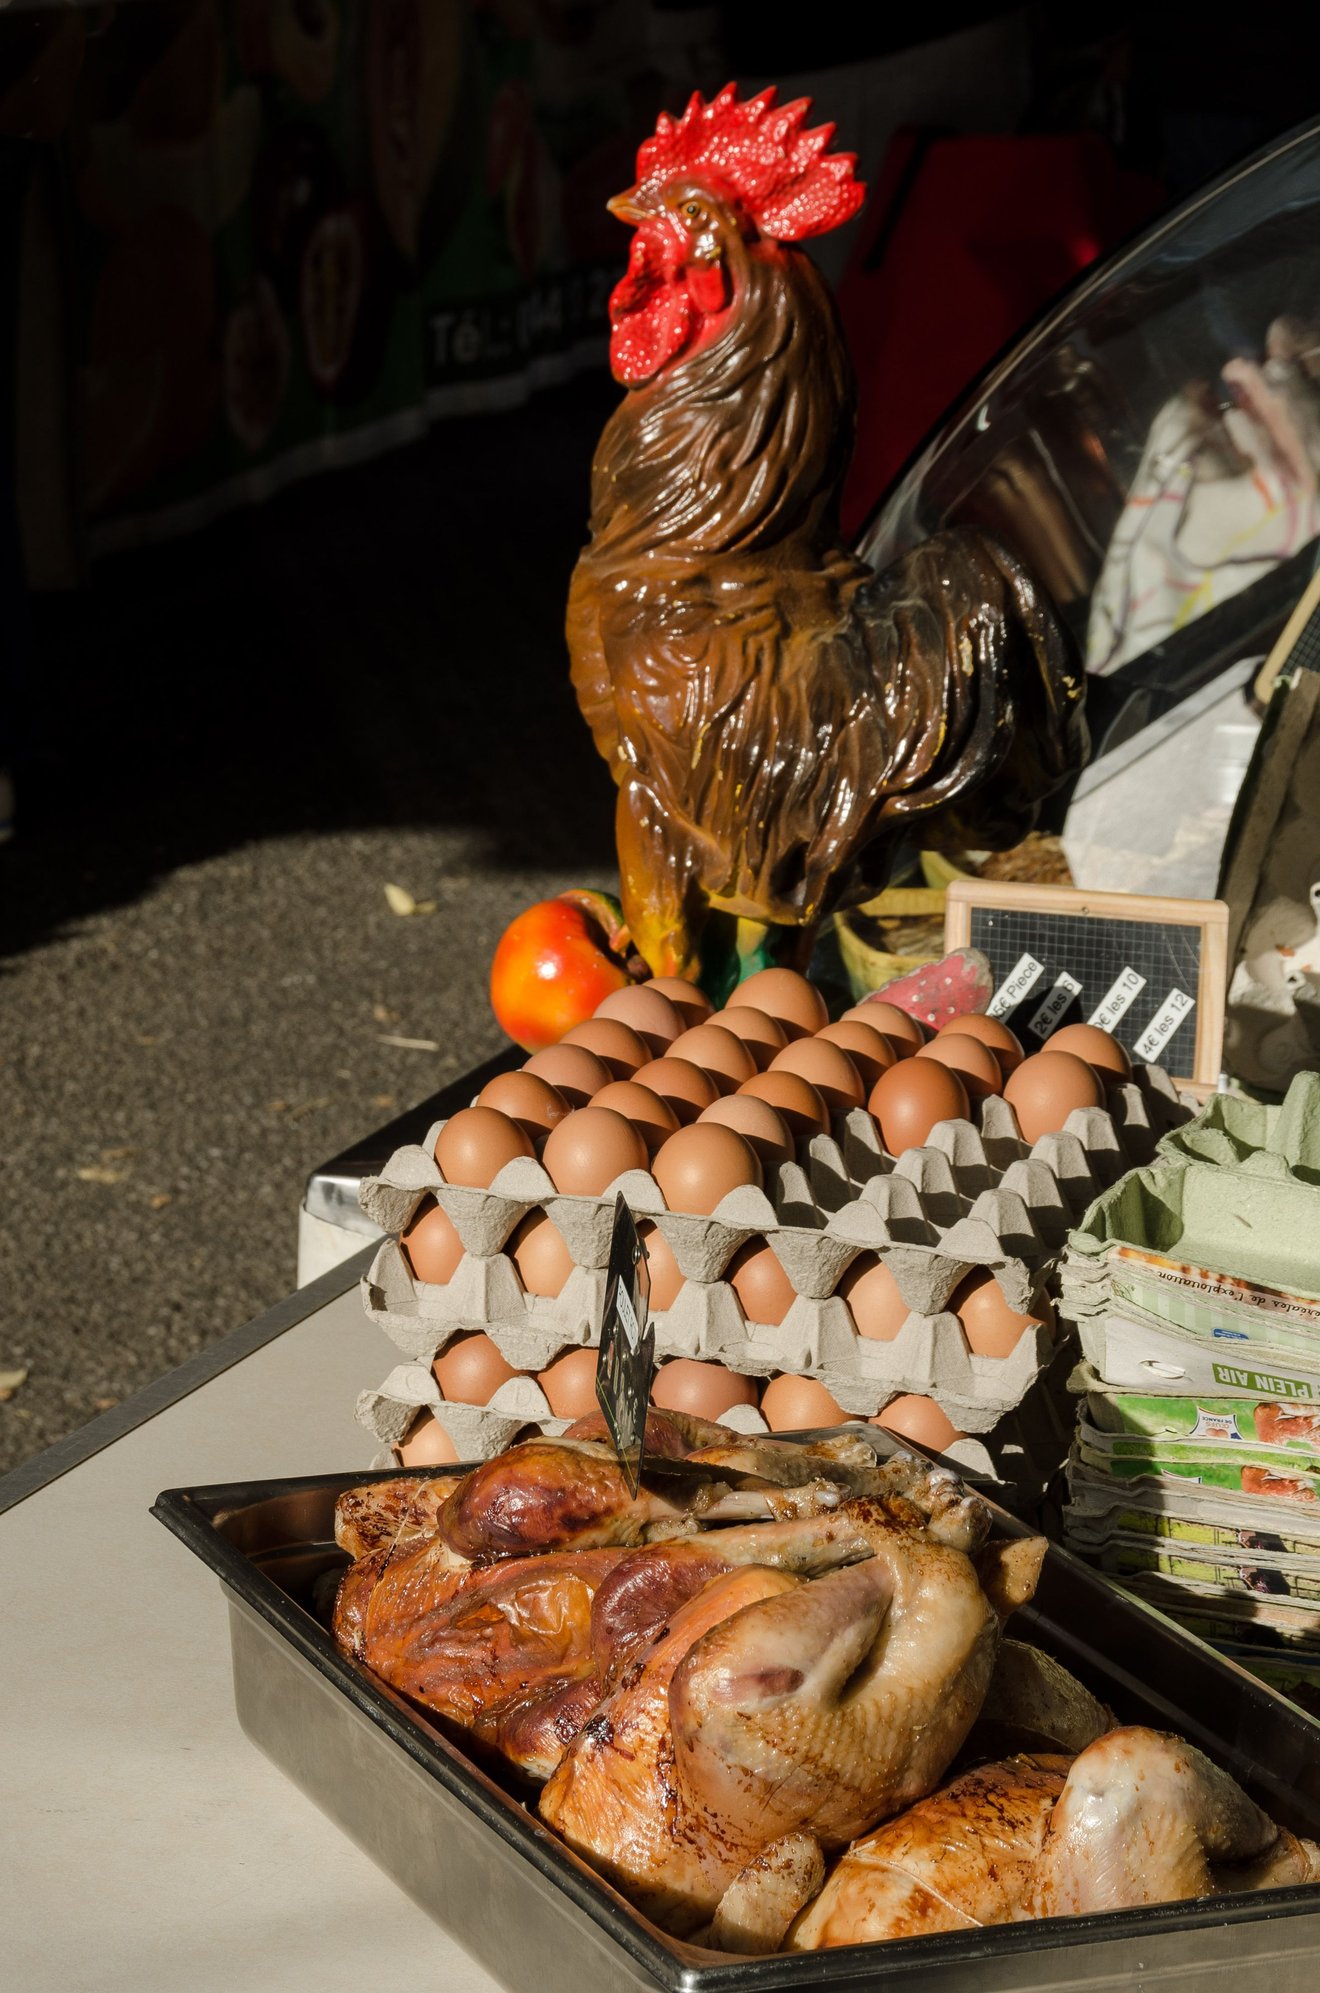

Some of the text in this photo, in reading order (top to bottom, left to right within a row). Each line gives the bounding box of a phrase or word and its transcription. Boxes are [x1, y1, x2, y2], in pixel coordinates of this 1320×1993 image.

[1105, 994, 1126, 1015] les
[1122, 973, 1139, 991] 10
[1034, 980, 1075, 1034] 2€ les 6
[1143, 993, 1189, 1054] 4€ les 12
[1249, 1294, 1266, 1306] de
[1271, 1299, 1320, 1320] éréales
[1216, 1366, 1248, 1385] AIR
[1255, 1375, 1312, 1398] PLEIN
